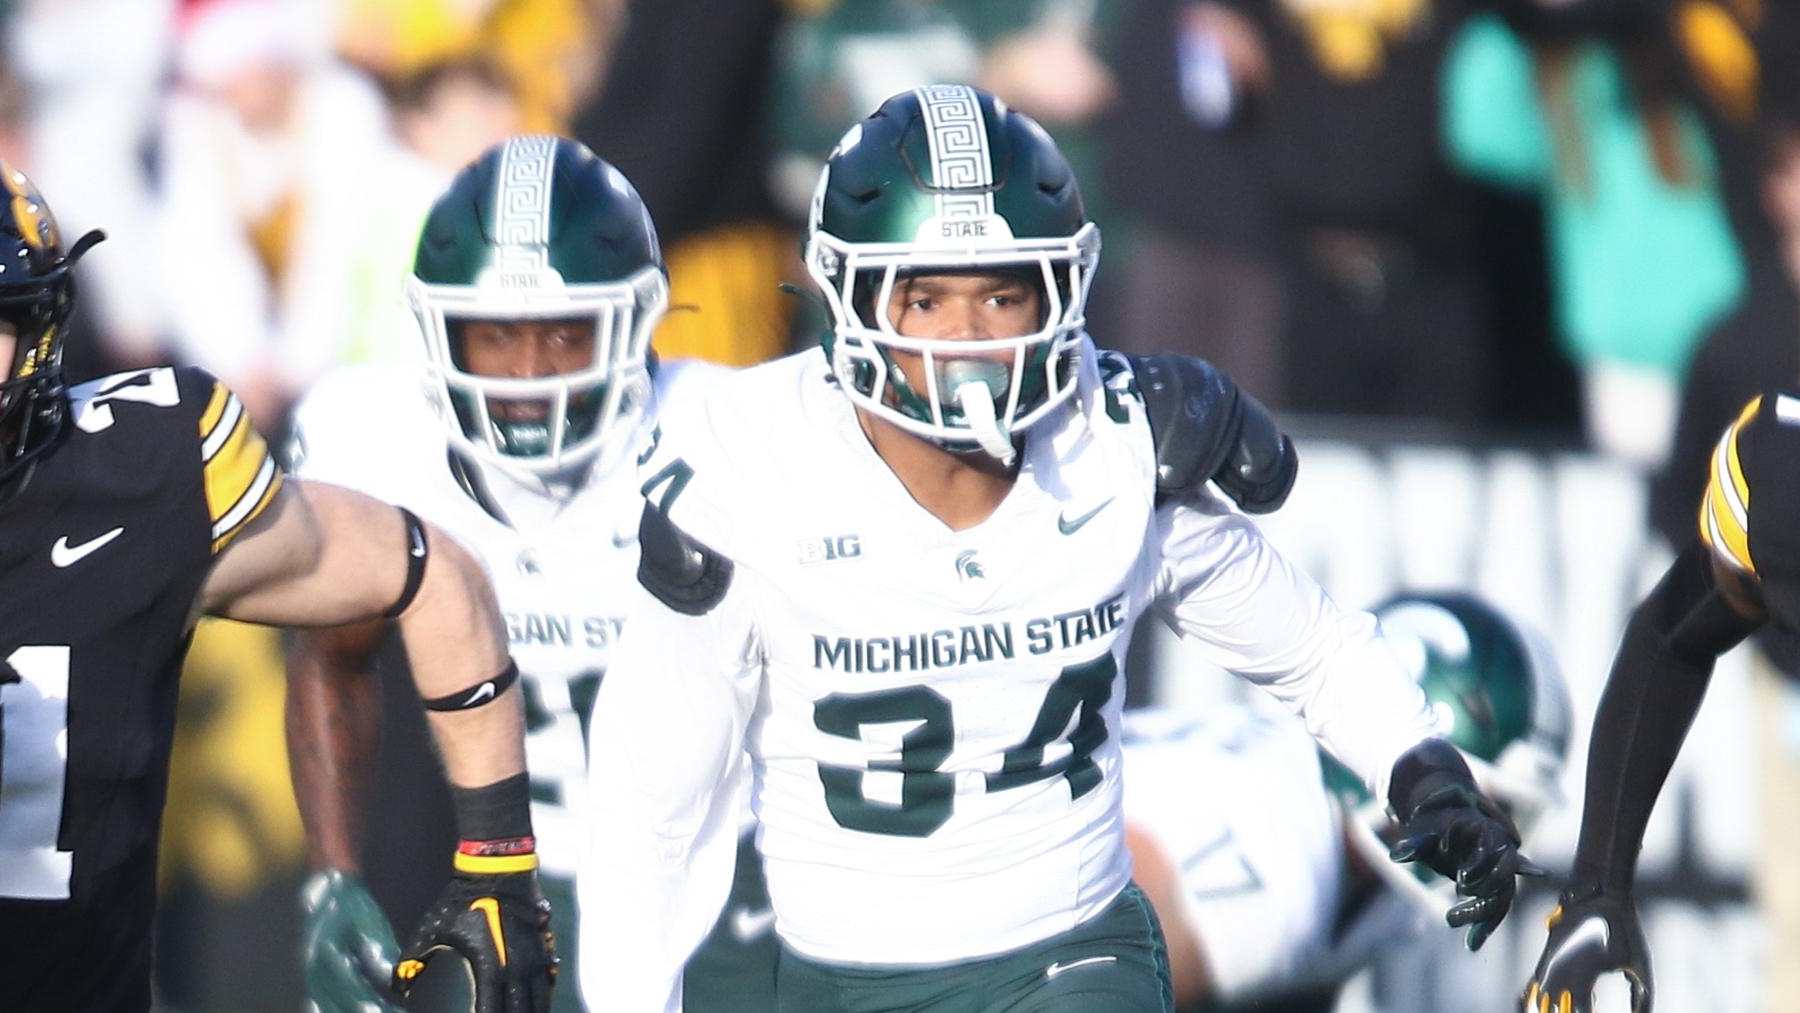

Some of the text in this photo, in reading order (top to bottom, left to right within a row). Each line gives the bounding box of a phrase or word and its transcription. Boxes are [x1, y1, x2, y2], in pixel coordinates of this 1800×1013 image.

[941, 220, 989, 237] STATE
[812, 591, 1126, 674] MICHIGAN STATE
[812, 650, 1118, 838] 34
